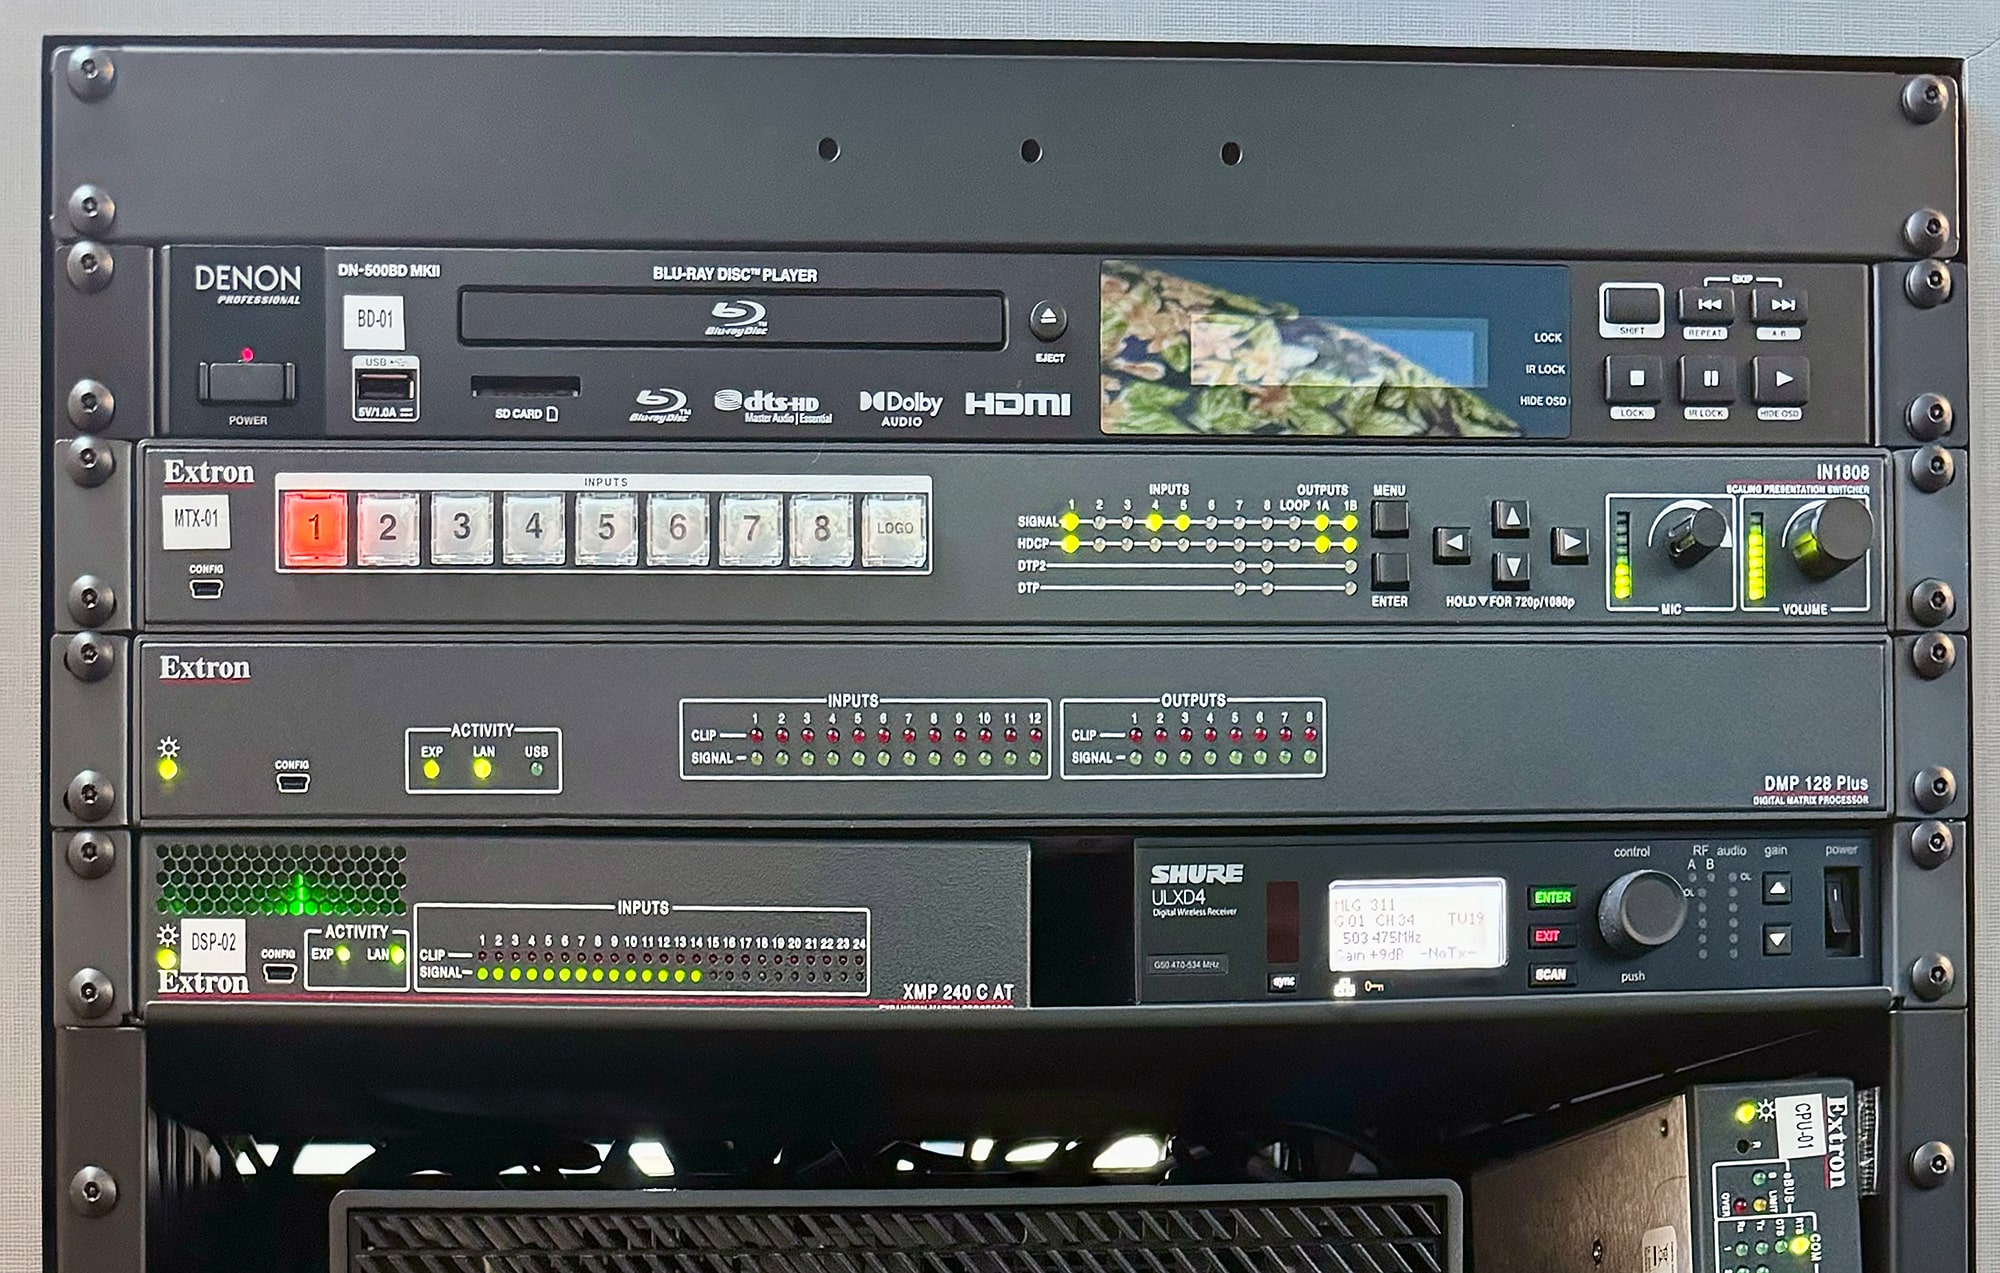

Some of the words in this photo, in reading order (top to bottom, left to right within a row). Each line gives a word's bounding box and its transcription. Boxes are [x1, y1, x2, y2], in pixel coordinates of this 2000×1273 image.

[338, 263, 408, 278] DN-500BD
[410, 264, 441, 278] MKII
[653, 266, 715, 281] BLU-RAY
[762, 269, 818, 283] PLAYER
[195, 265, 301, 291] DENON
[217, 295, 301, 305] PROFESSIONAL
[358, 309, 393, 328] BD-01
[1534, 332, 1562, 343] LOCK
[1619, 327, 1645, 336] SHIFT
[1688, 329, 1722, 338] REPEAT
[365, 358, 387, 367] USB
[1035, 353, 1066, 364] EJECT
[1526, 364, 1537, 375] IR
[1538, 364, 1566, 375] LOCK
[887, 391, 944, 417] Dolby
[965, 392, 1071, 416] HDMI
[1520, 395, 1544, 406] HIDE
[1545, 395, 1567, 406] OSD
[358, 407, 397, 419] 5V/1.0A
[495, 408, 514, 420] SD
[515, 408, 543, 420] CARD
[745, 412, 772, 423] Master
[772, 413, 794, 423] Audio
[800, 414, 832, 424] Essential
[1620, 408, 1644, 417] LOCK
[1688, 408, 1698, 418] IR
[1699, 408, 1724, 418] LOCK
[1760, 409, 1779, 418] HIDE
[1780, 409, 1800, 418] OSD
[229, 416, 268, 426] POWER
[881, 417, 923, 428] AUDIO
[163, 459, 255, 483] Extron
[1816, 464, 1870, 481] IN1808
[584, 477, 629, 487] INPUTS
[1149, 484, 1190, 496] INPUTS
[1297, 484, 1349, 497] OUTPUTS
[1373, 485, 1406, 497] MENU
[1726, 484, 1762, 494] SCALING
[1764, 484, 1826, 494] PRESENTATION
[1827, 485, 1870, 494] SWITCHER
[1280, 499, 1310, 510] LOOP
[1316, 499, 1330, 510] 1A
[1344, 499, 1358, 510] 1B
[174, 508, 218, 528] MTX-01
[1018, 516, 1060, 528] SIGNAL
[308, 513, 321, 541] 1
[379, 514, 397, 541] 2
[452, 513, 472, 540] 3
[525, 513, 544, 539] 4
[598, 513, 616, 540] 5
[669, 514, 688, 540] 6
[743, 514, 761, 541] 7
[814, 514, 832, 542] 8
[877, 522, 914, 535] LOGO
[1018, 538, 1050, 550] HDCP
[189, 564, 224, 574] CONFIG
[1018, 560, 1046, 572] DTP2
[1018, 582, 1040, 594] DTP
[1371, 596, 1408, 608] ENTER
[1446, 596, 1479, 608] HOLD
[1490, 596, 1513, 608] FOR
[1515, 596, 1576, 611] 720p/1080p
[1662, 603, 1682, 616] MIC
[1782, 603, 1828, 616] VOLUME
[159, 655, 251, 680] Extron
[827, 694, 880, 708] INPUTS
[1161, 693, 1227, 708] OUTPUTS
[978, 712, 992, 725] 10
[1004, 712, 1016, 725] 11
[1028, 712, 1042, 725] 12
[451, 723, 515, 738] ACTIVITY
[691, 729, 717, 742] CLIP
[1072, 730, 1097, 742] CLIP
[421, 746, 444, 758] EXP
[473, 746, 496, 758] LAN
[525, 746, 549, 758] USB
[691, 752, 734, 765] SIGNAL
[1072, 752, 1113, 764] SIGNAL
[275, 760, 310, 770] CONFIG
[1764, 775, 1800, 792] DMP
[1805, 776, 1832, 791] 128
[1836, 775, 1869, 791] Plus
[1753, 796, 1786, 806] DIGITAL
[1786, 796, 1817, 806] MATRIX
[1818, 795, 1870, 805] PROCESSOR
[1614, 846, 1651, 858] control
[1693, 845, 1709, 856] RF
[1717, 845, 1748, 856] audio
[1764, 845, 1788, 858] gain
[1825, 845, 1858, 857] power
[1687, 858, 1696, 870] A
[1706, 858, 1715, 870] B
[1150, 864, 1244, 885] SHURE
[1152, 888, 1206, 906] ULXD4
[1534, 891, 1572, 904] ENTER
[618, 900, 670, 916] INPUTS
[1370, 898, 1395, 912] 311
[1152, 908, 1176, 919] Digital
[1177, 908, 1206, 917] Wireless
[1207, 907, 1238, 916] Receiver
[325, 924, 389, 940] ACTIVITY
[1534, 930, 1560, 942] EXIT
[192, 932, 236, 951] DSP-02
[624, 936, 638, 948] 10
[641, 936, 654, 948] 11
[658, 936, 671, 948] 12
[674, 936, 687, 948] 13
[690, 936, 704, 949] 14
[706, 936, 720, 949] 15
[722, 936, 736, 949] 16
[739, 936, 752, 949] 17
[755, 937, 769, 949] 18
[772, 937, 785, 949] 19
[788, 937, 802, 949] 20
[804, 937, 818, 949] 21
[820, 937, 834, 950] 22
[836, 937, 850, 950] 23
[852, 937, 866, 950] 24
[261, 949, 296, 960] CONFIG
[312, 948, 334, 960] EXP
[368, 948, 390, 961] LAN
[420, 950, 446, 962] CLIP
[420, 966, 462, 978] SIGNAL
[1535, 968, 1567, 982] SCAN
[1621, 971, 1646, 984] push
[158, 970, 250, 994] Extron
[1272, 976, 1296, 989] sync
[903, 984, 938, 1000] XMP
[943, 984, 972, 1000] 240
[976, 984, 989, 1000] C
[992, 984, 1014, 1000] AT
[1795, 1103, 1814, 1150] CPU-01
[1826, 1096, 1848, 1190] Extron
[1784, 1172, 1795, 1204] eBUS
[1720, 1192, 1730, 1218] OVER
[1768, 1190, 1778, 1214] LIMIT
[1776, 1218, 1785, 1237] CTS
[1795, 1217, 1804, 1235] RTS
[1810, 1233, 1822, 1262] COM
